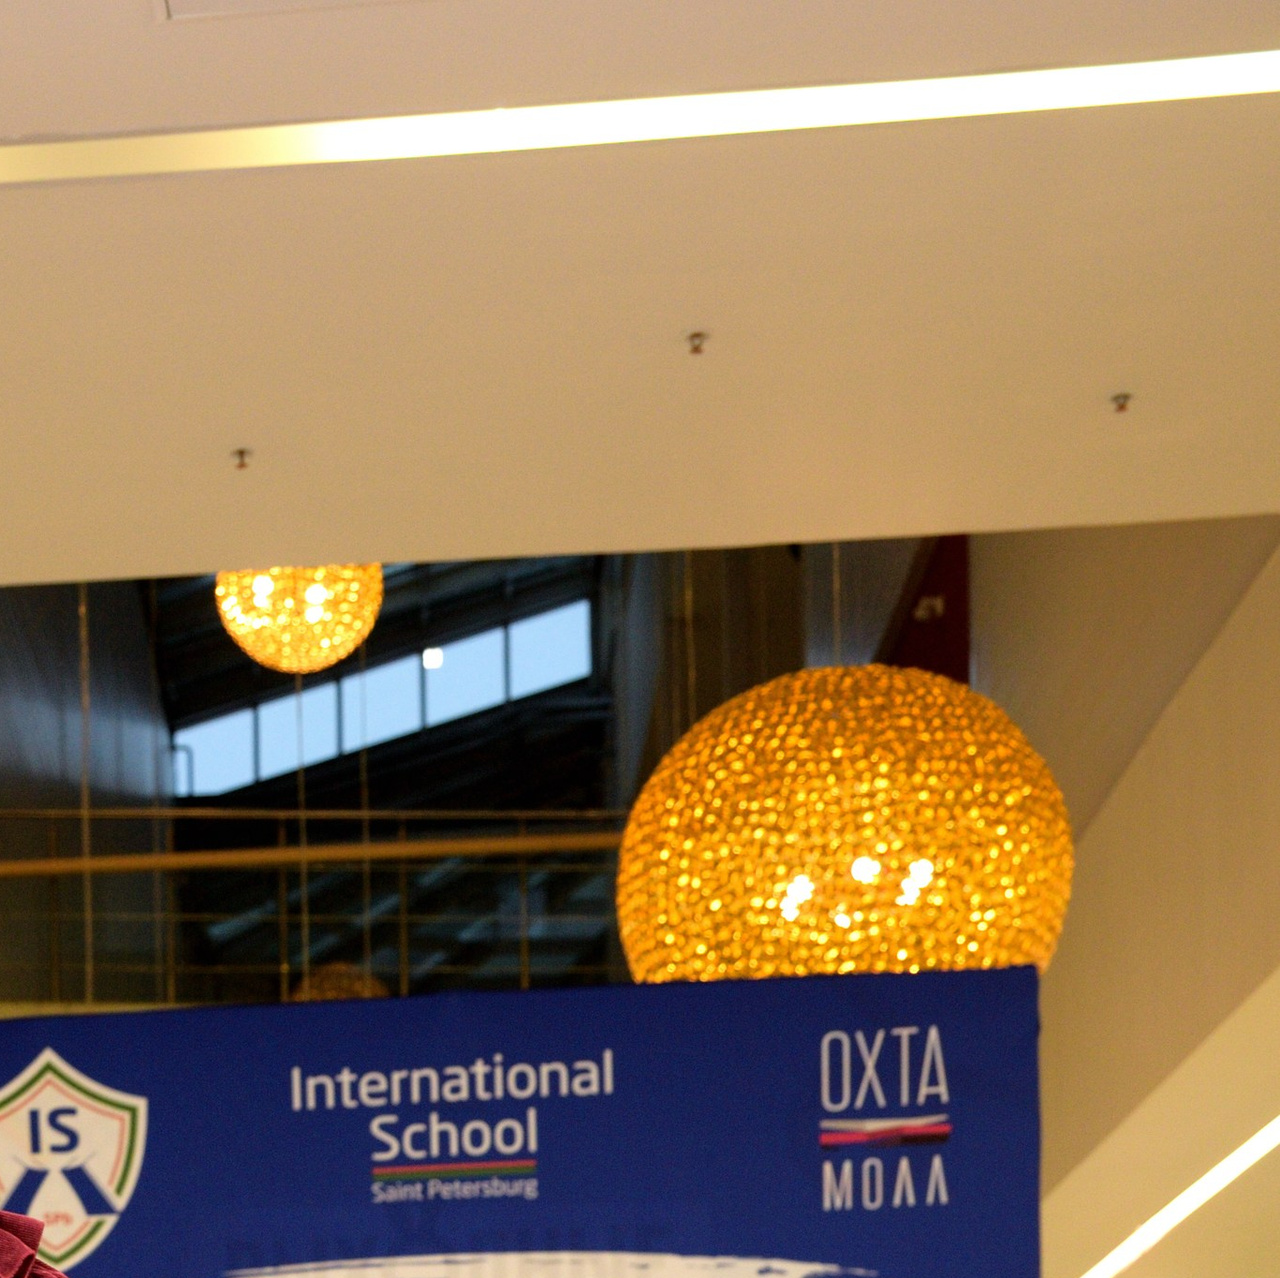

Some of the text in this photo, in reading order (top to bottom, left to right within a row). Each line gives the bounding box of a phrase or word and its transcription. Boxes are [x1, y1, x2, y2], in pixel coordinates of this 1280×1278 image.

[290, 1049, 615, 1111] International
[820, 1025, 950, 1113] ОХТА
[29, 1107, 81, 1154] IS
[370, 1107, 538, 1162] School
[371, 1177, 539, 1203] Saint Petersburg
[822, 1154, 949, 1212] МОЛЛ
